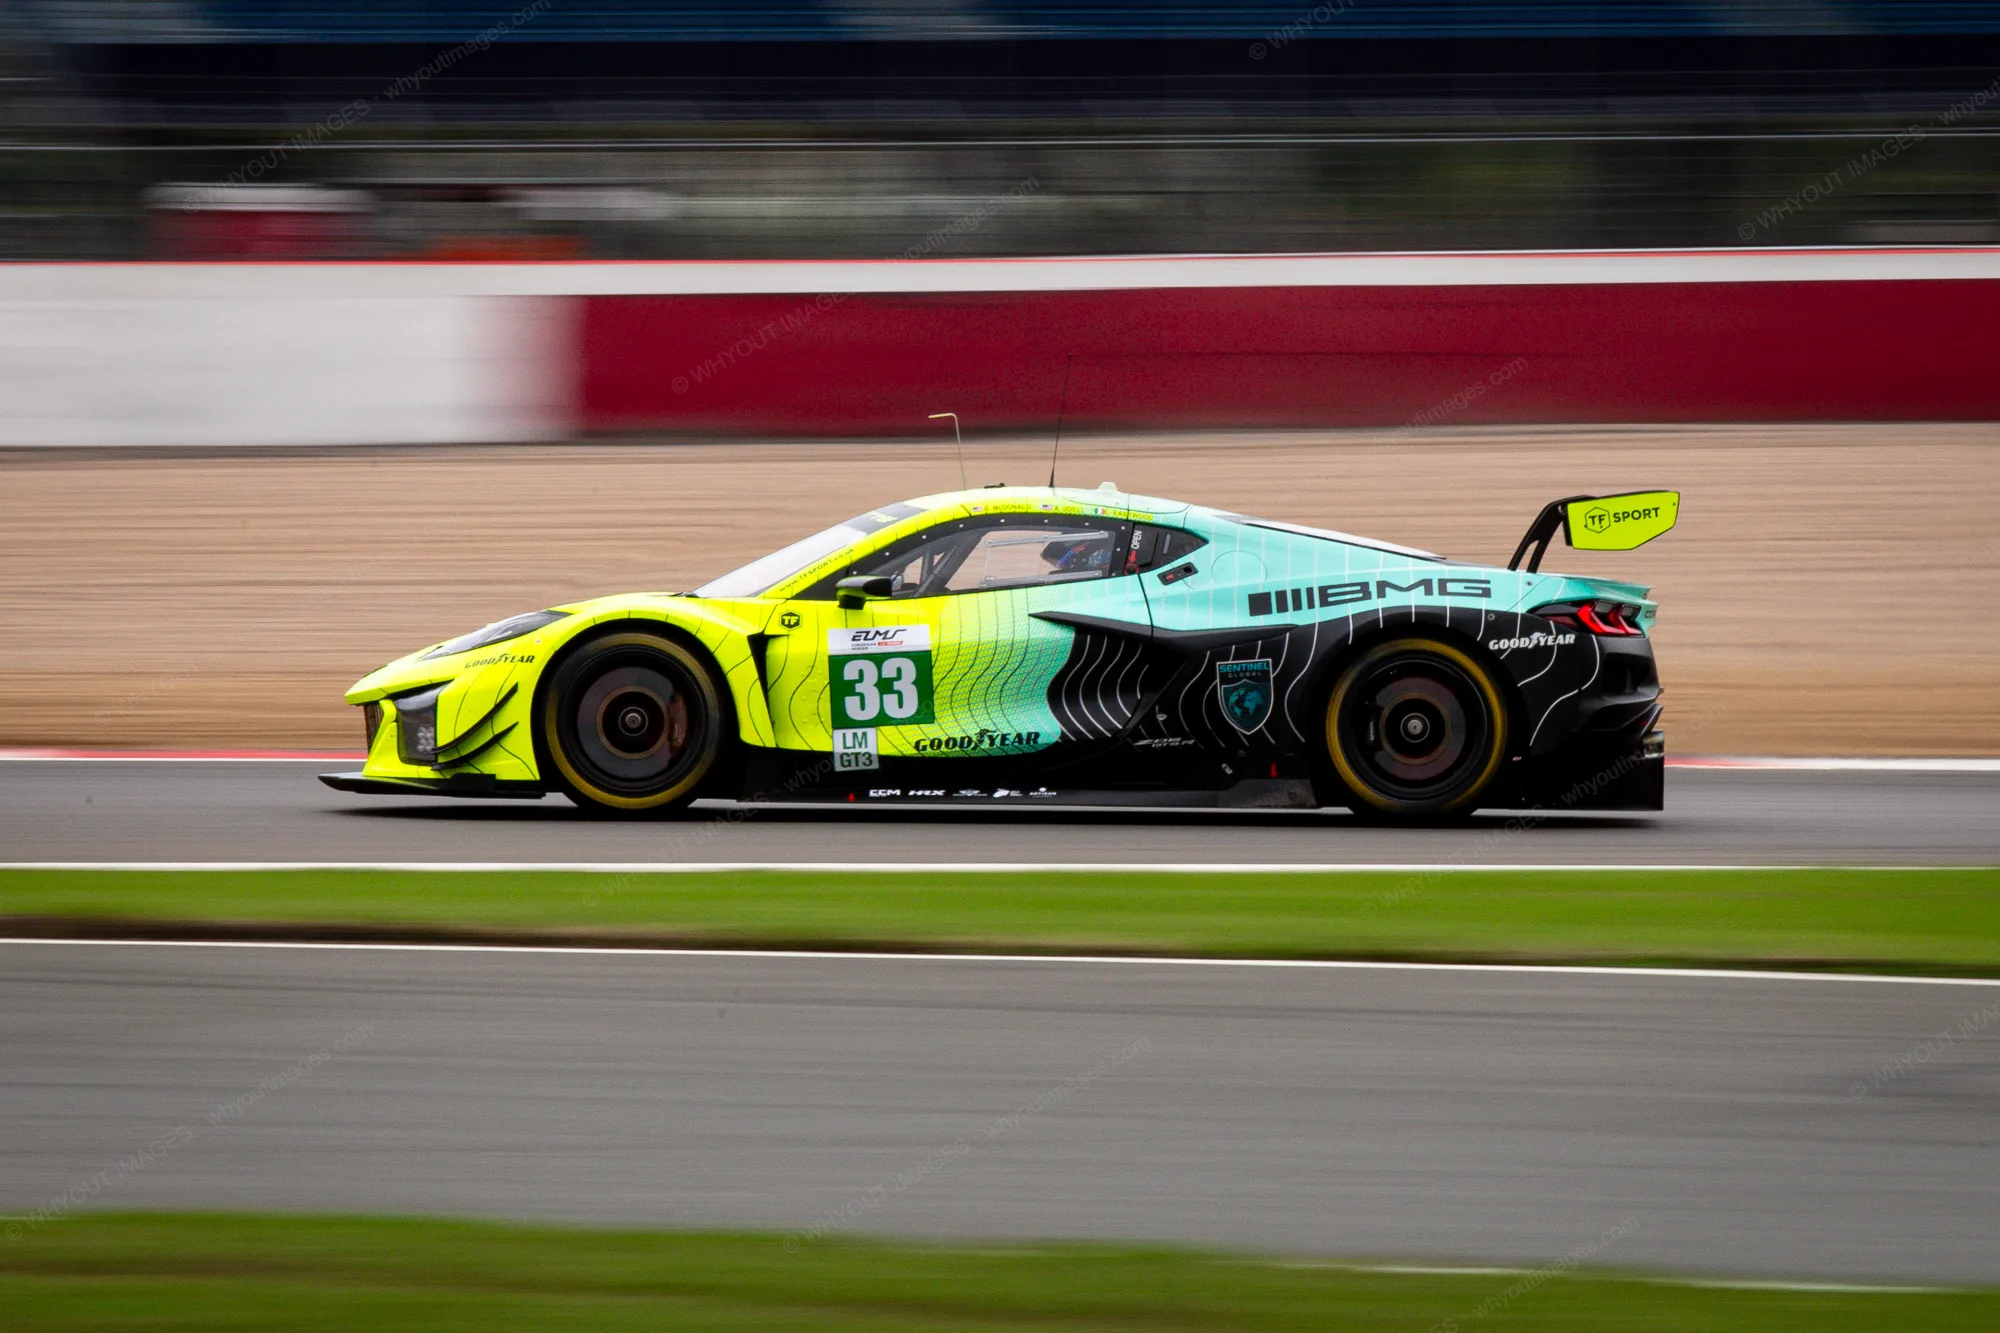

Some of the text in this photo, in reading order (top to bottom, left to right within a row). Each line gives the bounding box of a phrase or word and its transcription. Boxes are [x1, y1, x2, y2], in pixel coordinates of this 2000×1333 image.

[1588, 507, 1660, 526] TF SPORT
[1131, 530, 1142, 550] OPEN
[783, 616, 799, 625] TF
[1488, 632, 1575, 650] GOODYEAR
[1219, 662, 1269, 673] SENTINEL
[843, 657, 919, 721] 33
[842, 731, 868, 750] LM
[914, 729, 1040, 752] GOODYEAR
[839, 751, 873, 768] GT3
